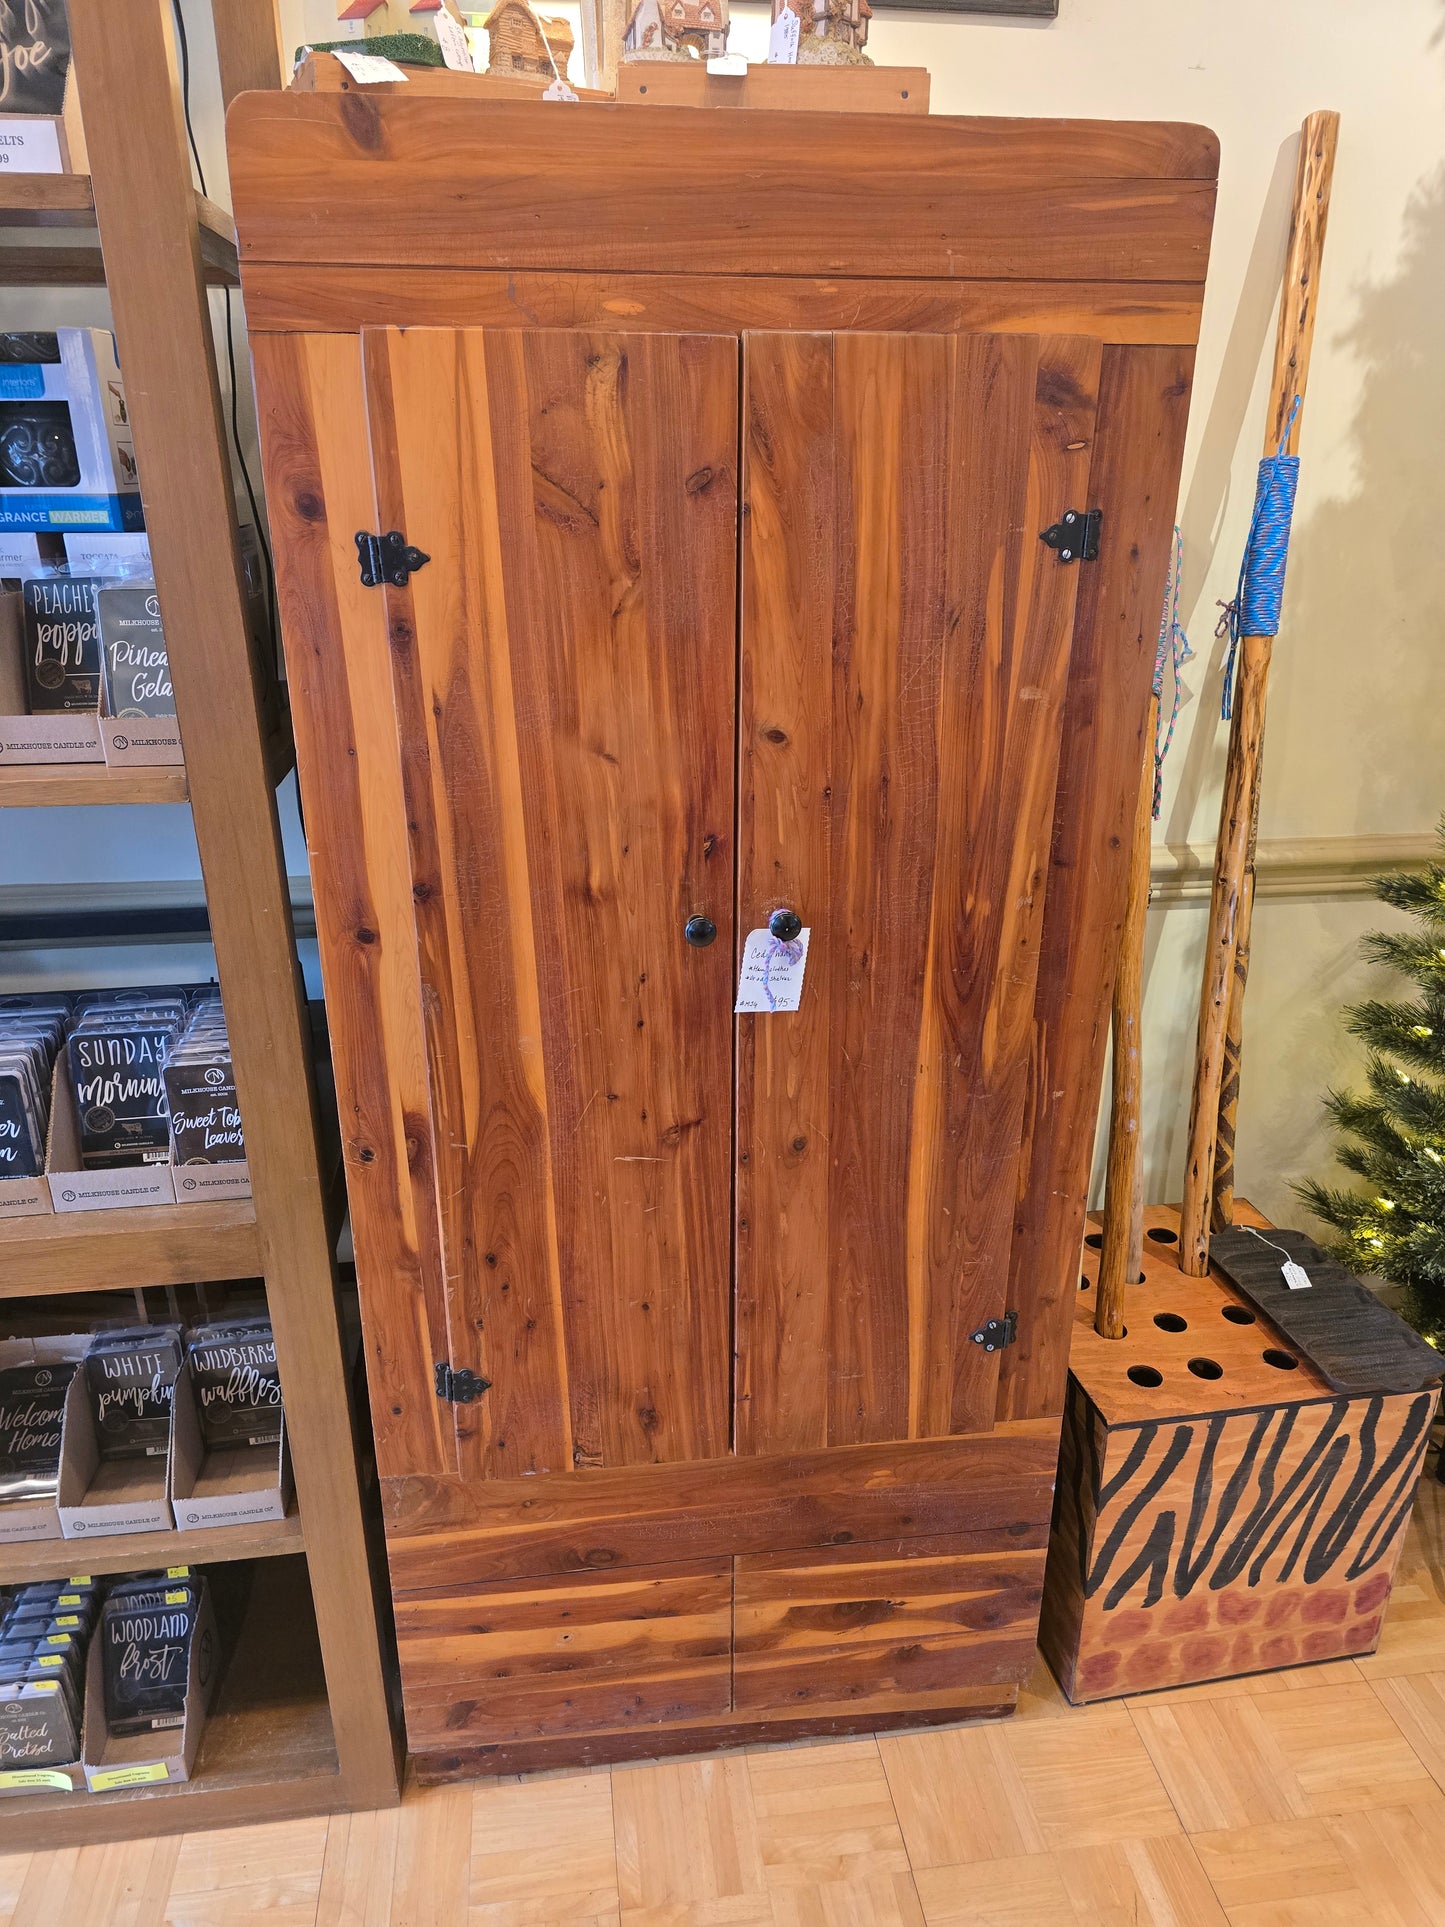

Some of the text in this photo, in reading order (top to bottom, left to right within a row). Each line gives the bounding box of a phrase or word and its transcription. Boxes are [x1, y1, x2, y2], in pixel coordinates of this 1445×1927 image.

[51, 511, 108, 522] WARMER
[33, 584, 96, 615] PEACHE
[78, 1035, 166, 1068] SUNDAY
[181, 1086, 218, 1095] MILKHOUSE
[172, 1107, 218, 1135] Sweet
[204, 1128, 244, 1149] Leaves
[78, 1190, 120, 1198] MILKHOUSE
[199, 1179, 239, 1187] MILKHOUSE
[102, 1353, 165, 1379] WHITE
[194, 1342, 277, 1372] WILDBERRY
[201, 1365, 282, 1406] waffles
[8, 1428, 60, 1454] Home
[87, 1520, 124, 1528] MILKHOUSE
[125, 1518, 150, 1526] CANDLE
[201, 1512, 238, 1520] MILKHOUSE
[239, 1508, 263, 1516] CANDLE
[111, 1613, 189, 1645] WOODLAND
[120, 1642, 183, 1680] frost
